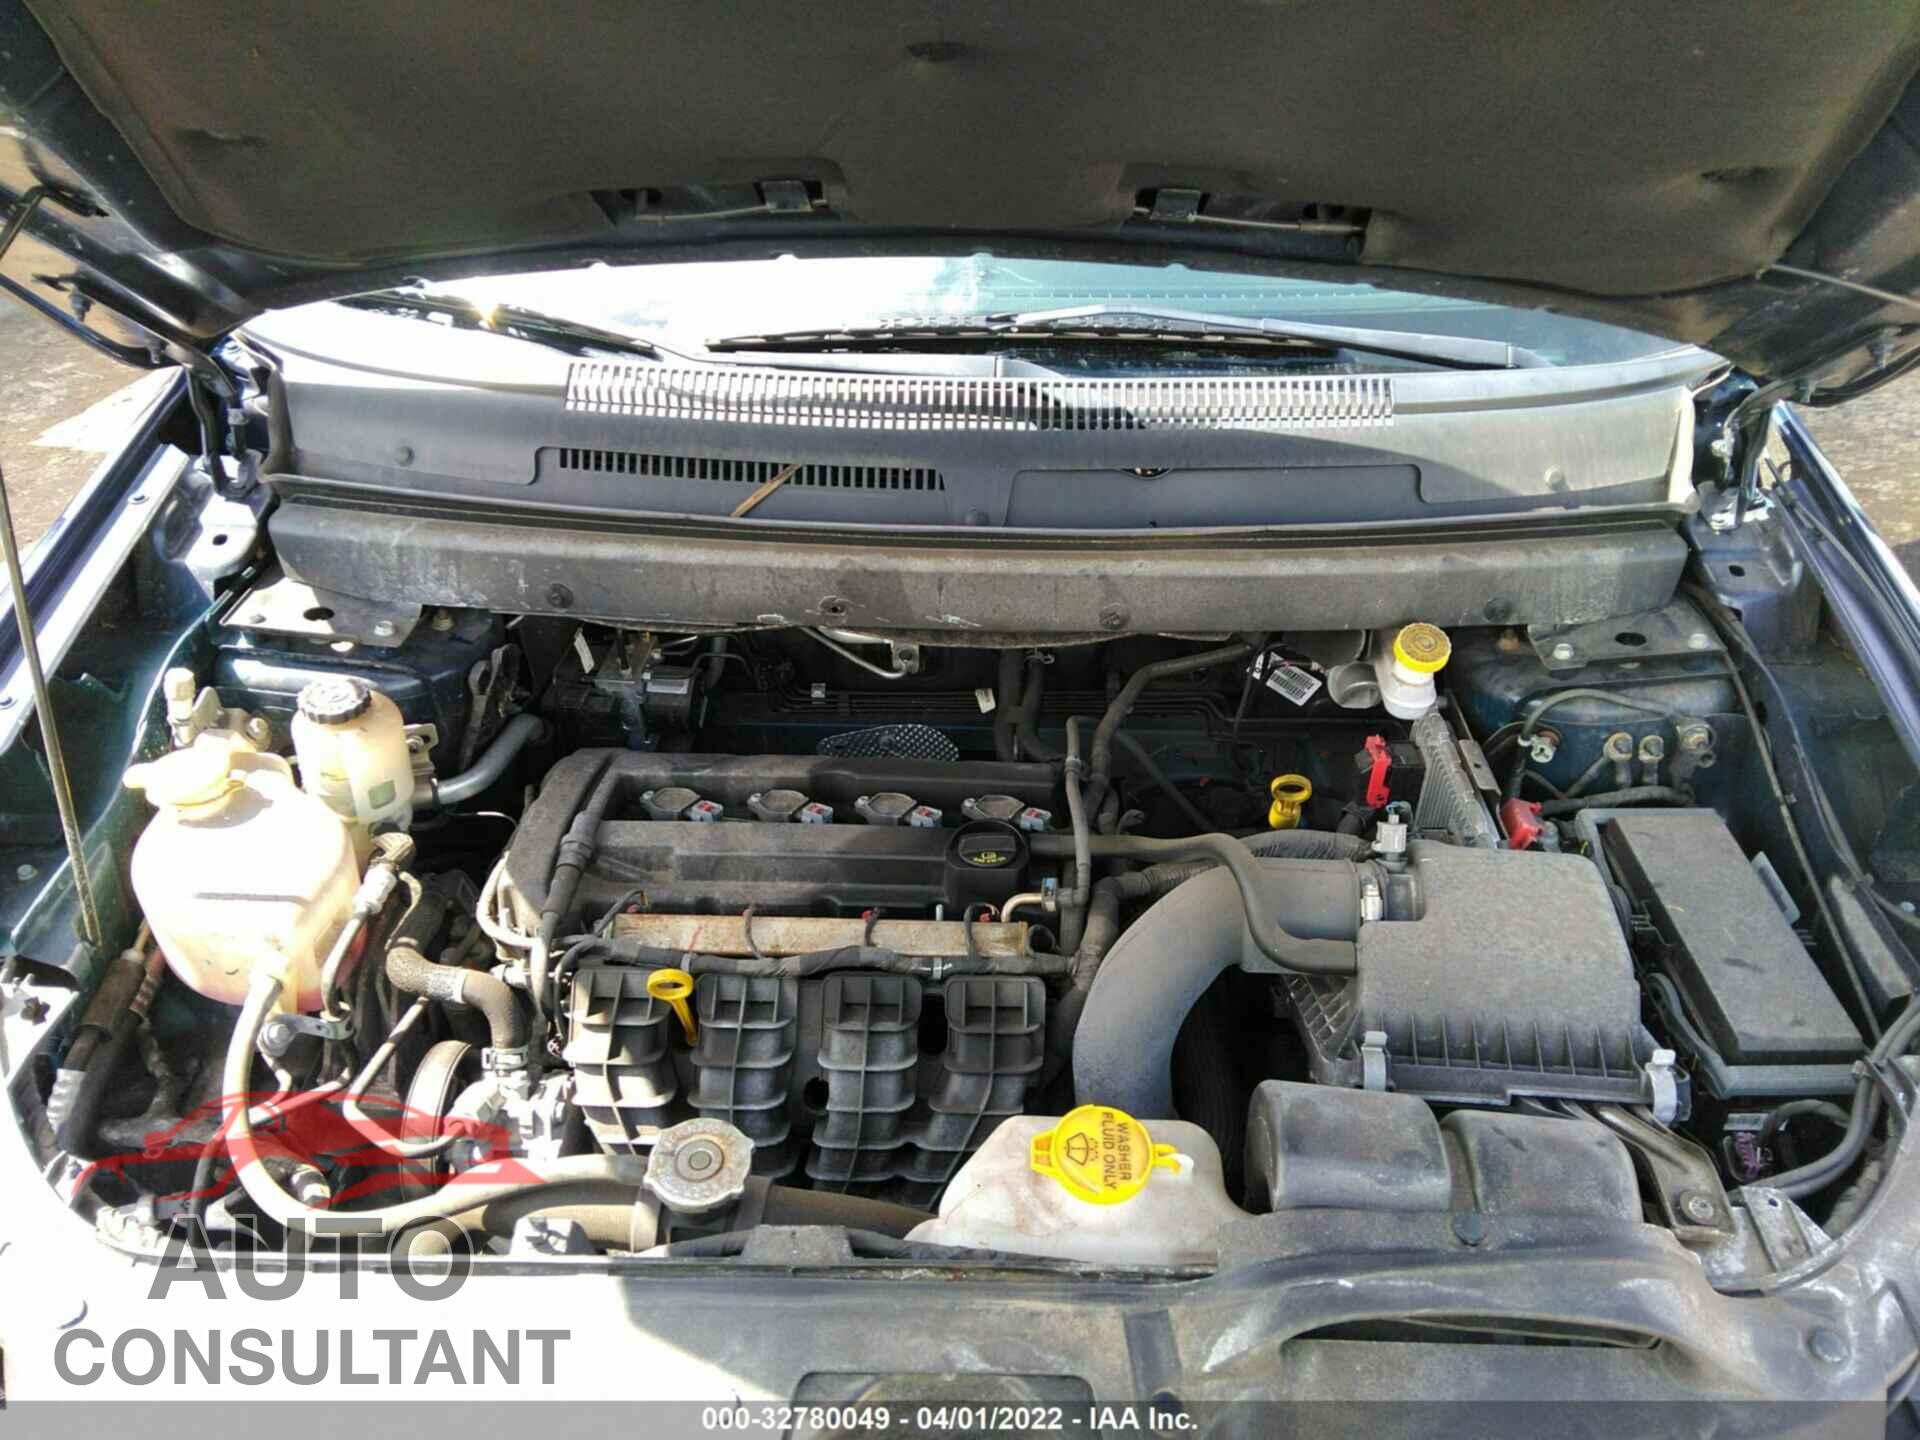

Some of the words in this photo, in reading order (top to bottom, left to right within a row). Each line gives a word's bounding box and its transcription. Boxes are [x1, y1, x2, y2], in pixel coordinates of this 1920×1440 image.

[1102, 1112, 1115, 1150] FLUID
[1117, 1122, 1132, 1180] WASHER
[1103, 1154, 1117, 1190] ONLY
